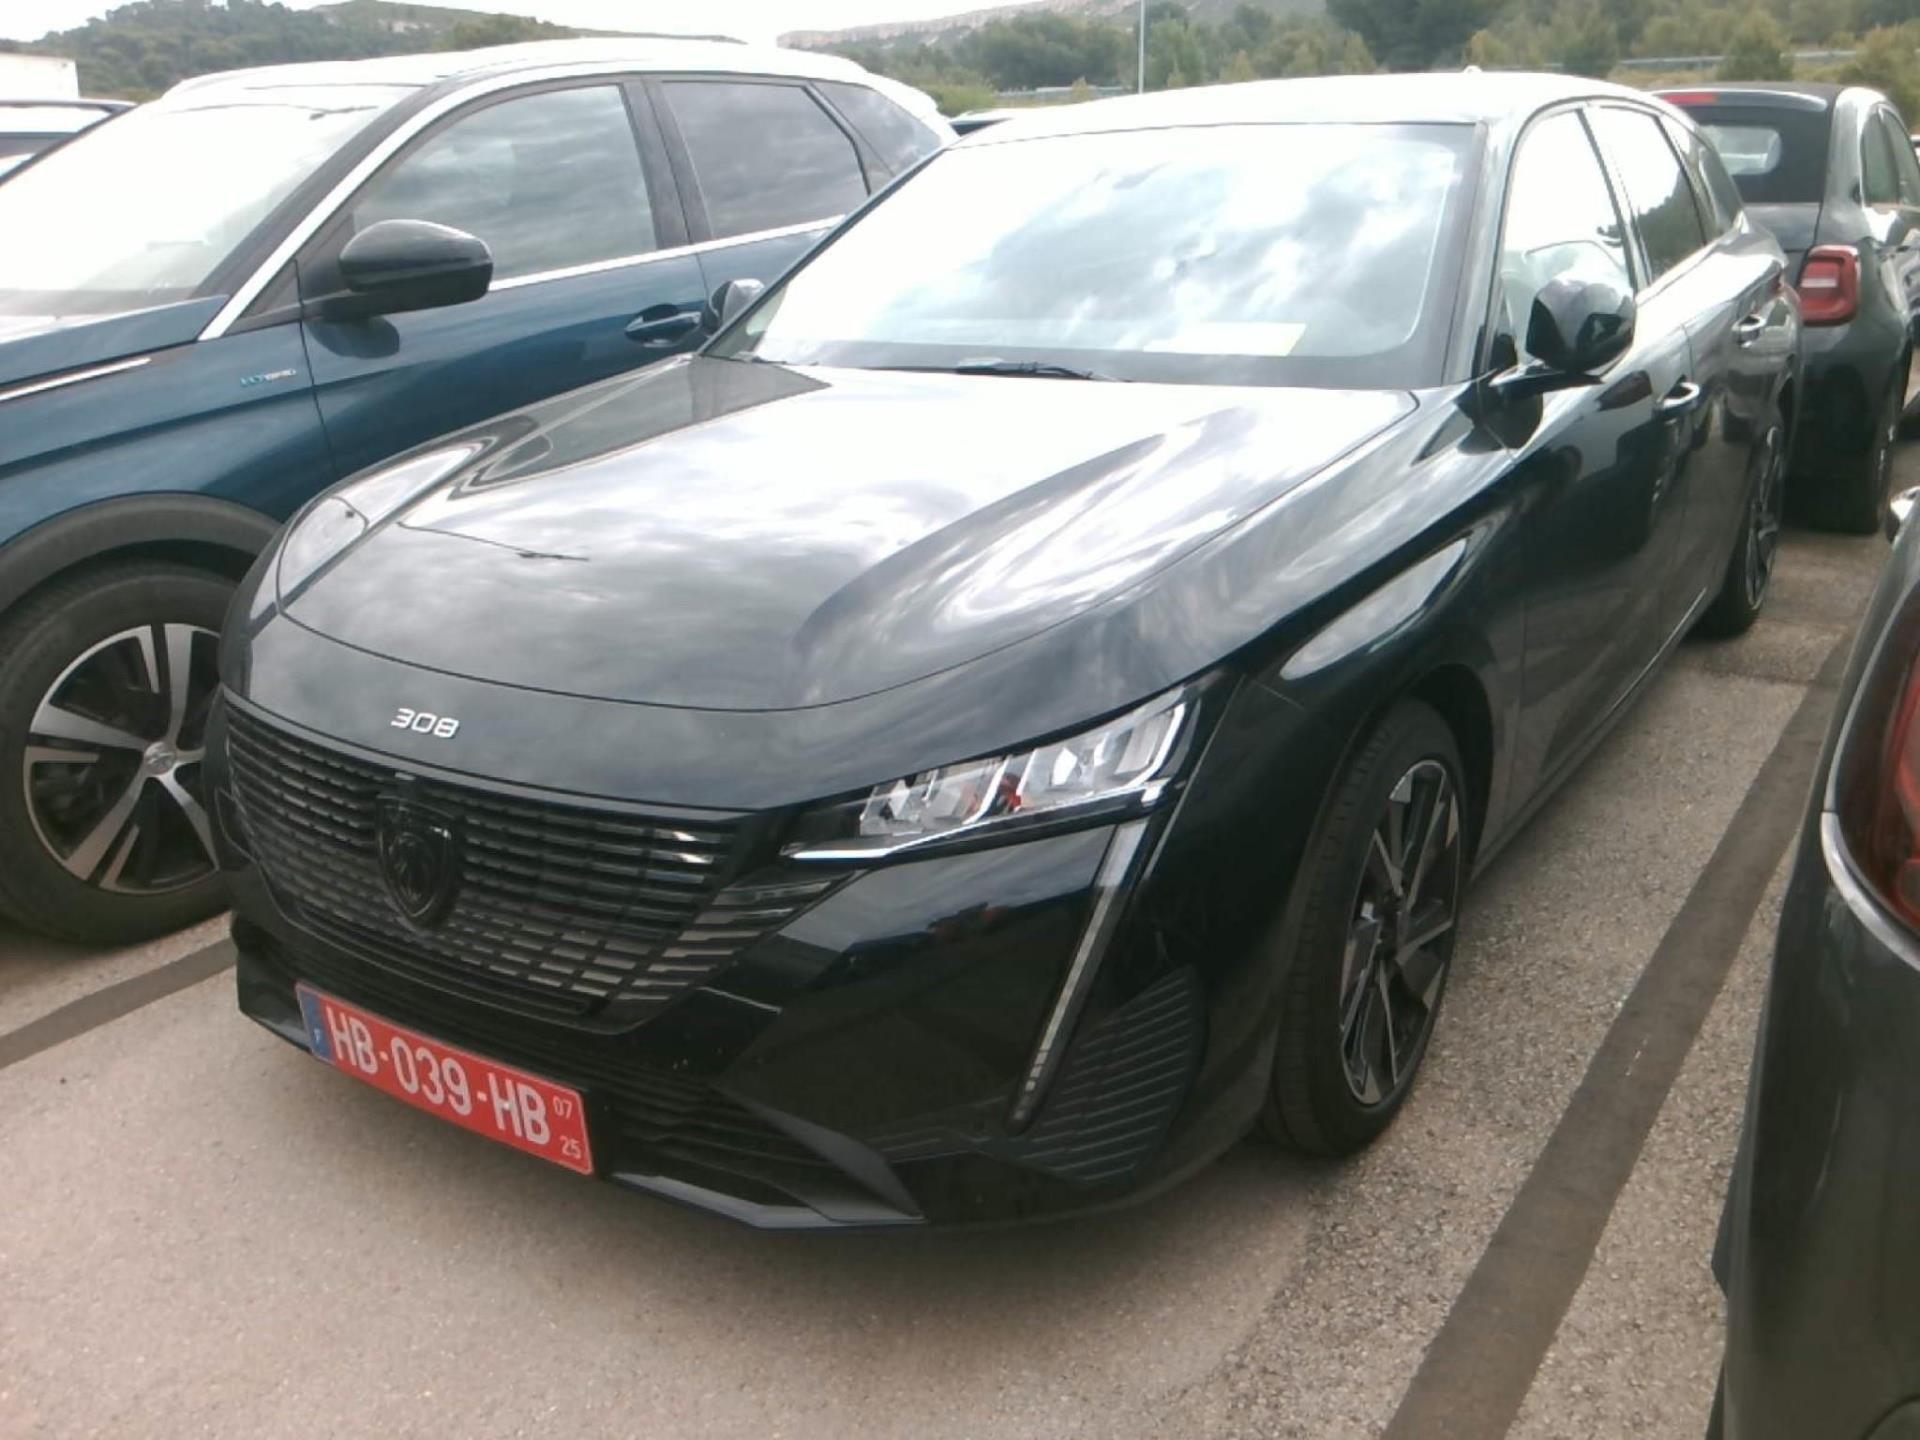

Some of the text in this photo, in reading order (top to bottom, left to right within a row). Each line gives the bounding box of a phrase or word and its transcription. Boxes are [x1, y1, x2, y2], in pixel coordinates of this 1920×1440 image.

[391, 708, 459, 738] 308
[326, 1006, 550, 1144] HB-039-HB
[553, 1096, 572, 1119] 07
[560, 1136, 581, 1160] 25
